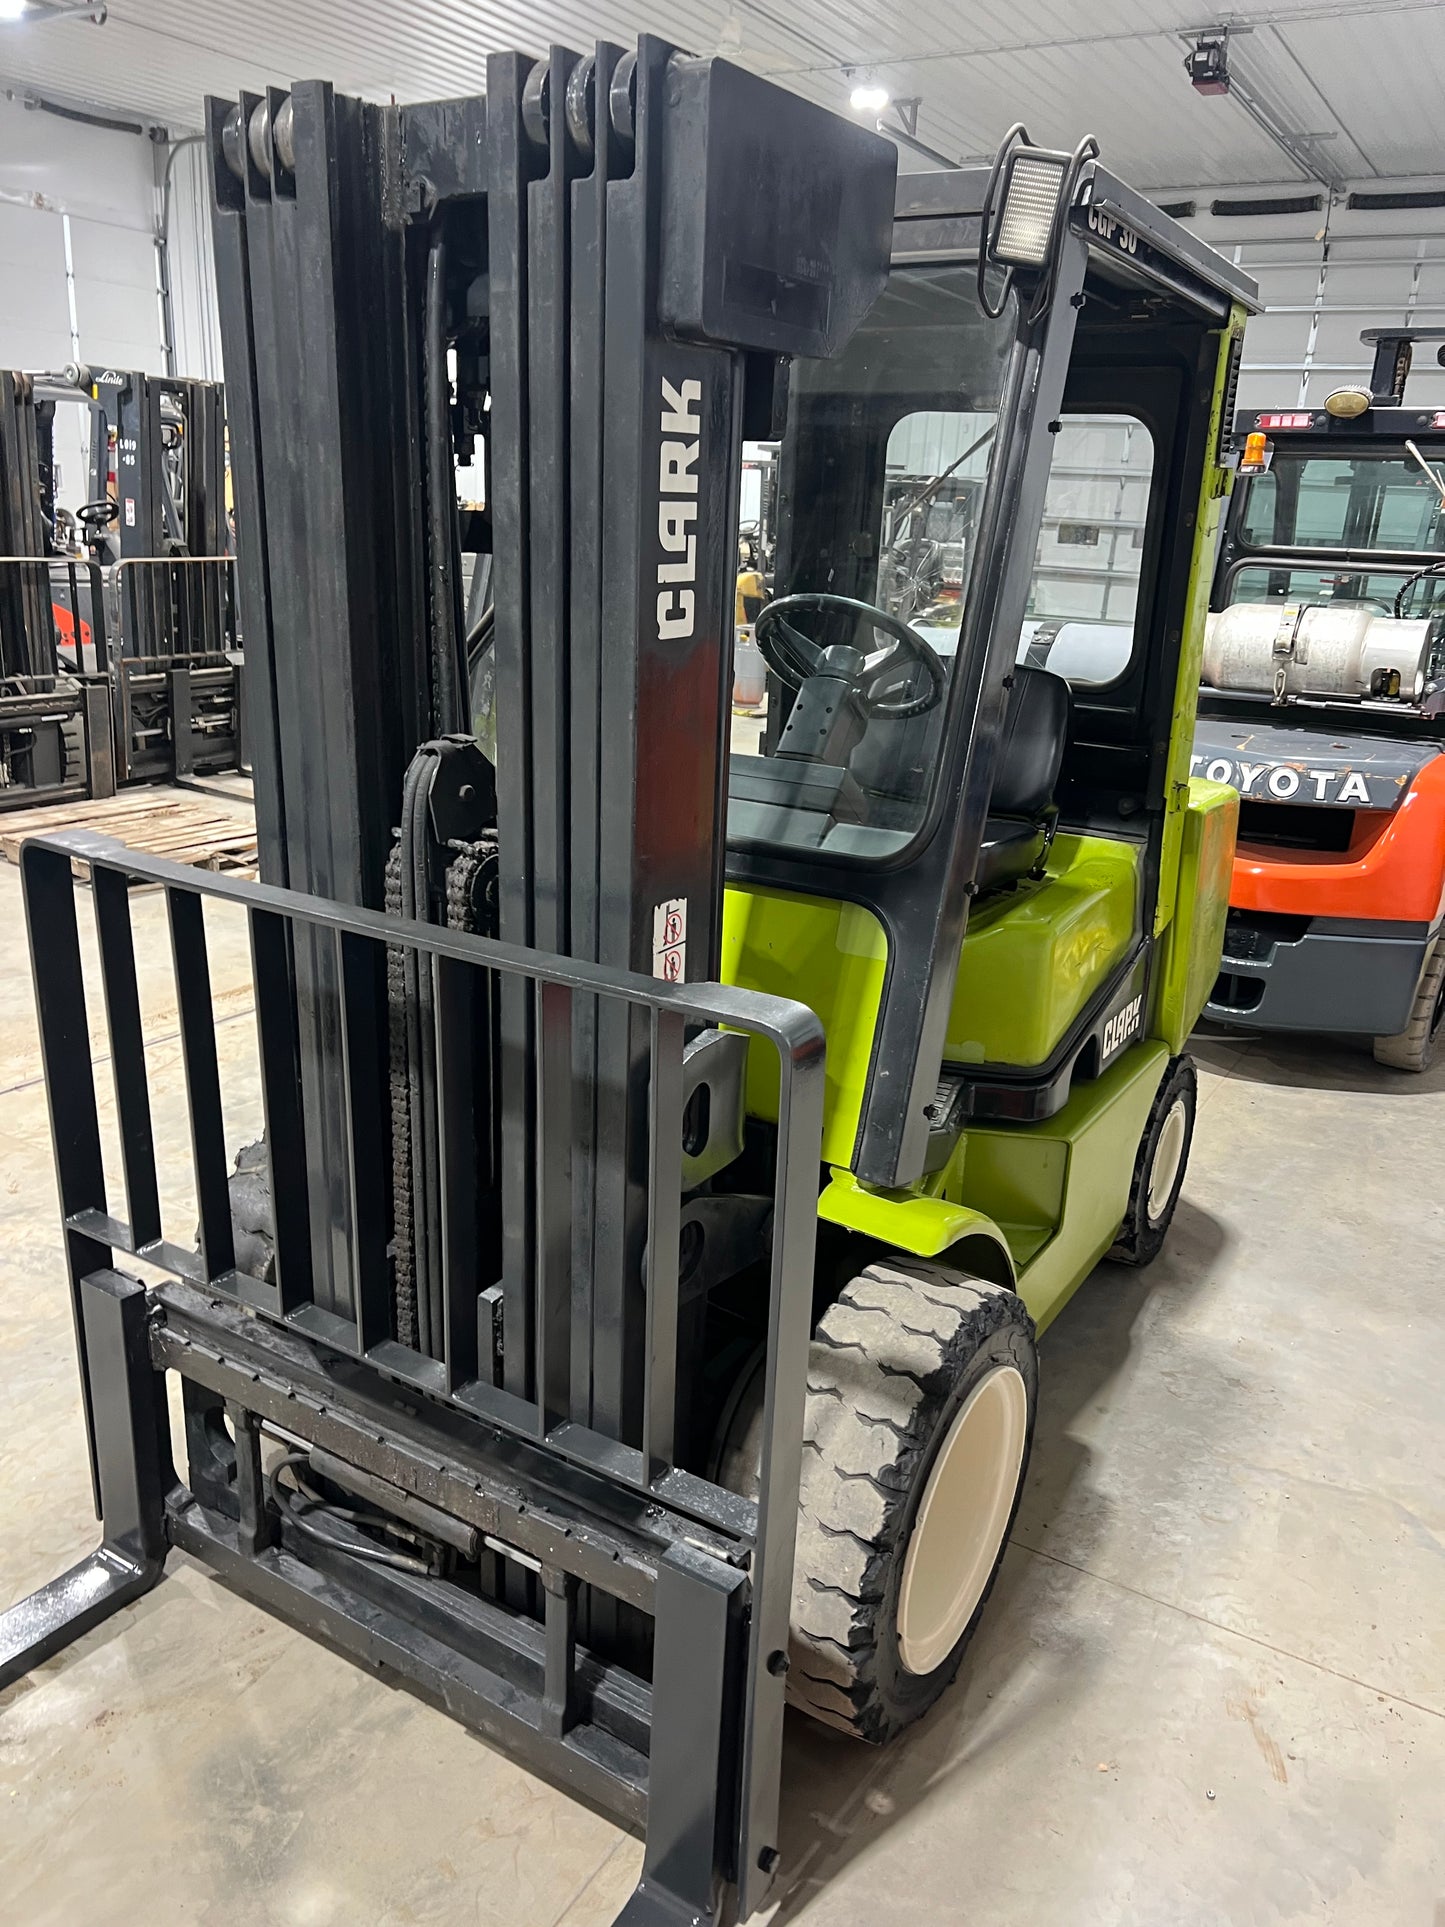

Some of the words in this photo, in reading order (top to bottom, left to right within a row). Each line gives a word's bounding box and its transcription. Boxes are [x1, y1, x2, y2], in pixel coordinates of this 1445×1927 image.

[1088, 206, 1117, 239] CGP
[1120, 229, 1137, 254] 30
[95, 370, 123, 386] Linde
[656, 376, 701, 640] CLARK
[1102, 994, 1142, 1059] CLARK
